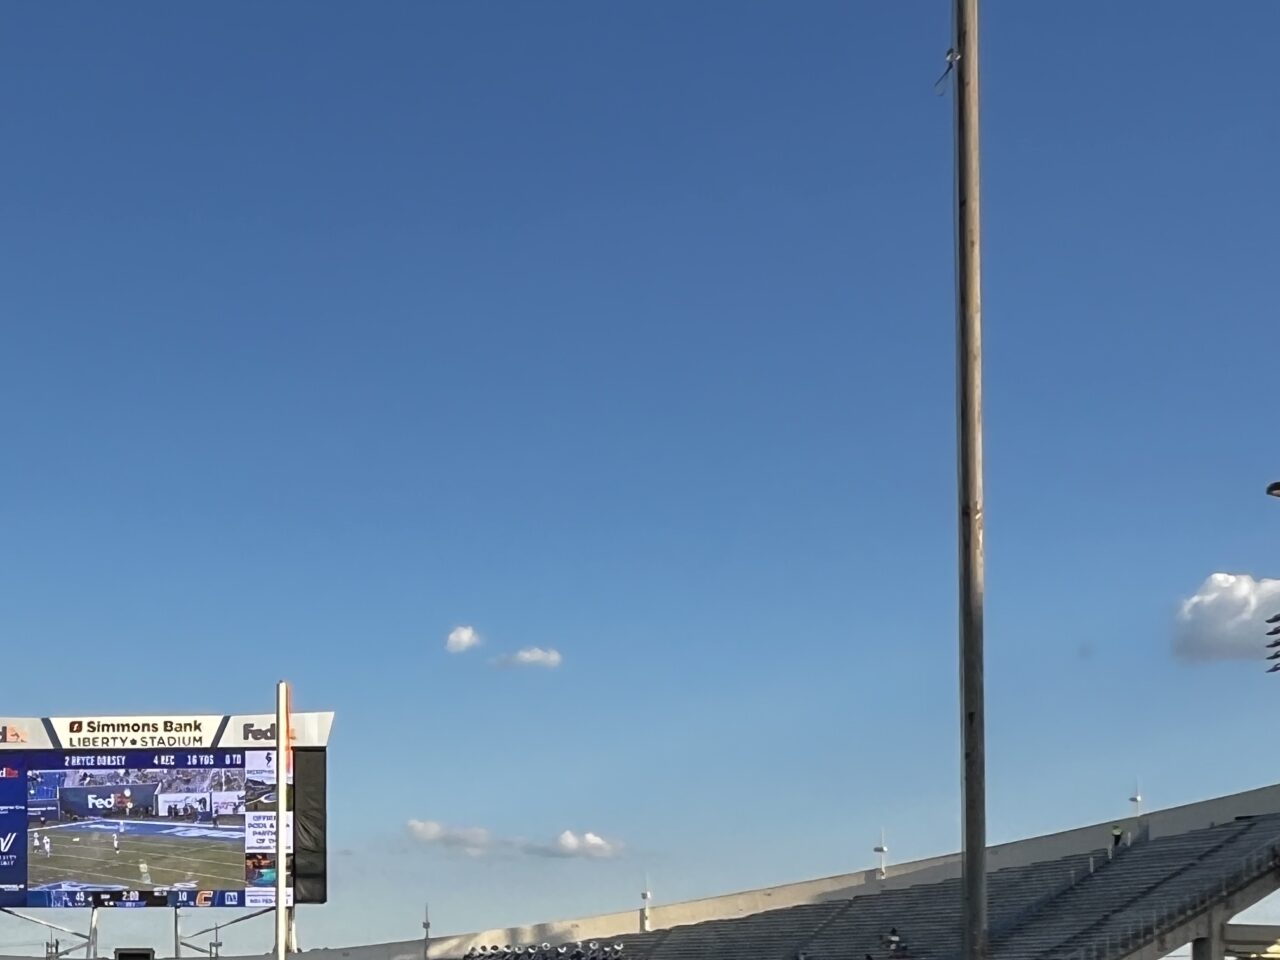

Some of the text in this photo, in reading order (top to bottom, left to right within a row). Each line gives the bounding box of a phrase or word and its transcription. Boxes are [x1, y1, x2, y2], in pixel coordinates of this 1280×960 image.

[87, 720, 202, 733] Simmons Bank
[70, 736, 202, 748] LIBERTY STADIUM
[153, 755, 158, 765] 4
